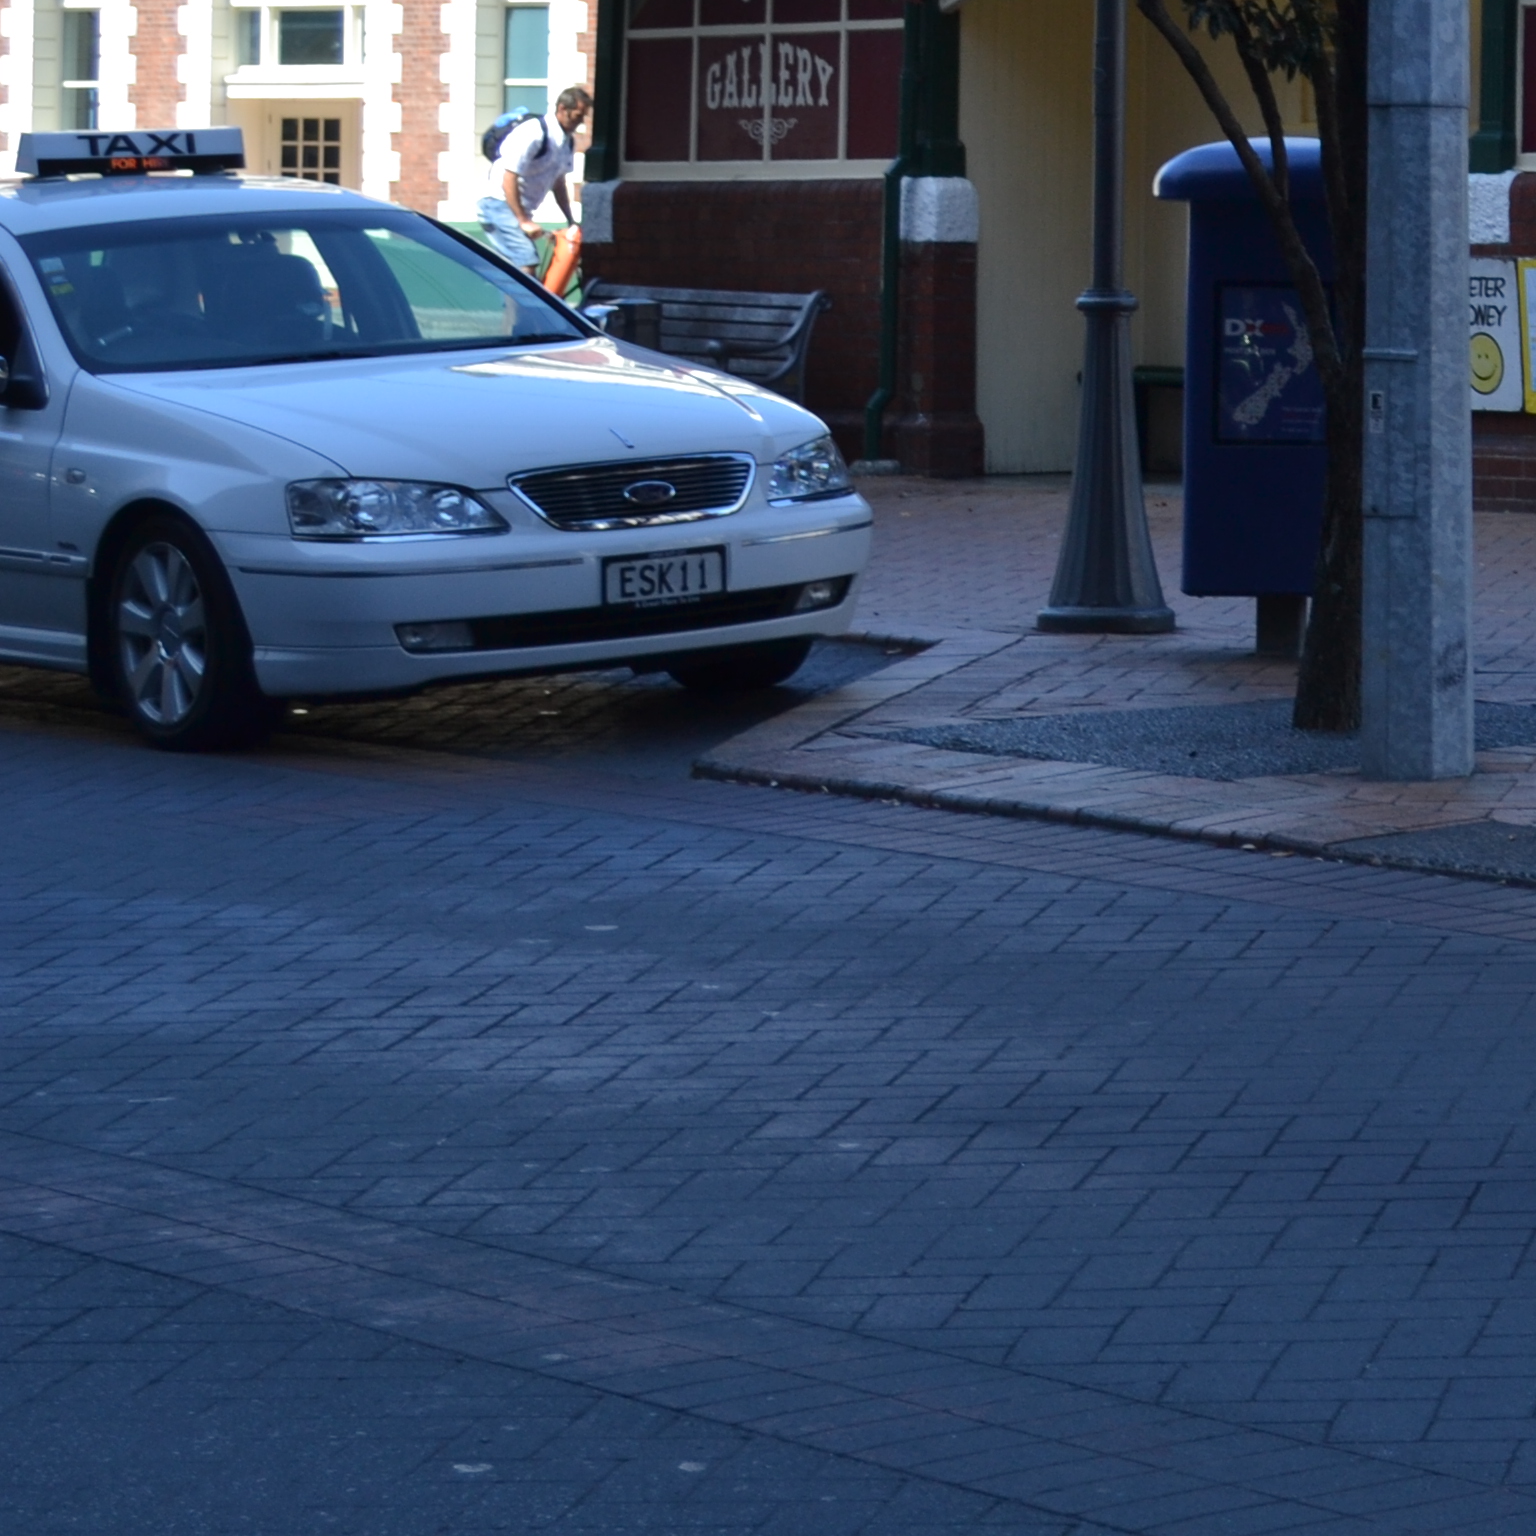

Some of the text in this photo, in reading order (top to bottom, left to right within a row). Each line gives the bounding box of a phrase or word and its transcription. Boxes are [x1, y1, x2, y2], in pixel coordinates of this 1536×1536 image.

[706, 42, 834, 110] GALLERY
[76, 133, 197, 157] TAXI
[111, 157, 168, 170] FOR HI
[1224, 318, 1264, 337] DX
[619, 558, 709, 598] ESK11
